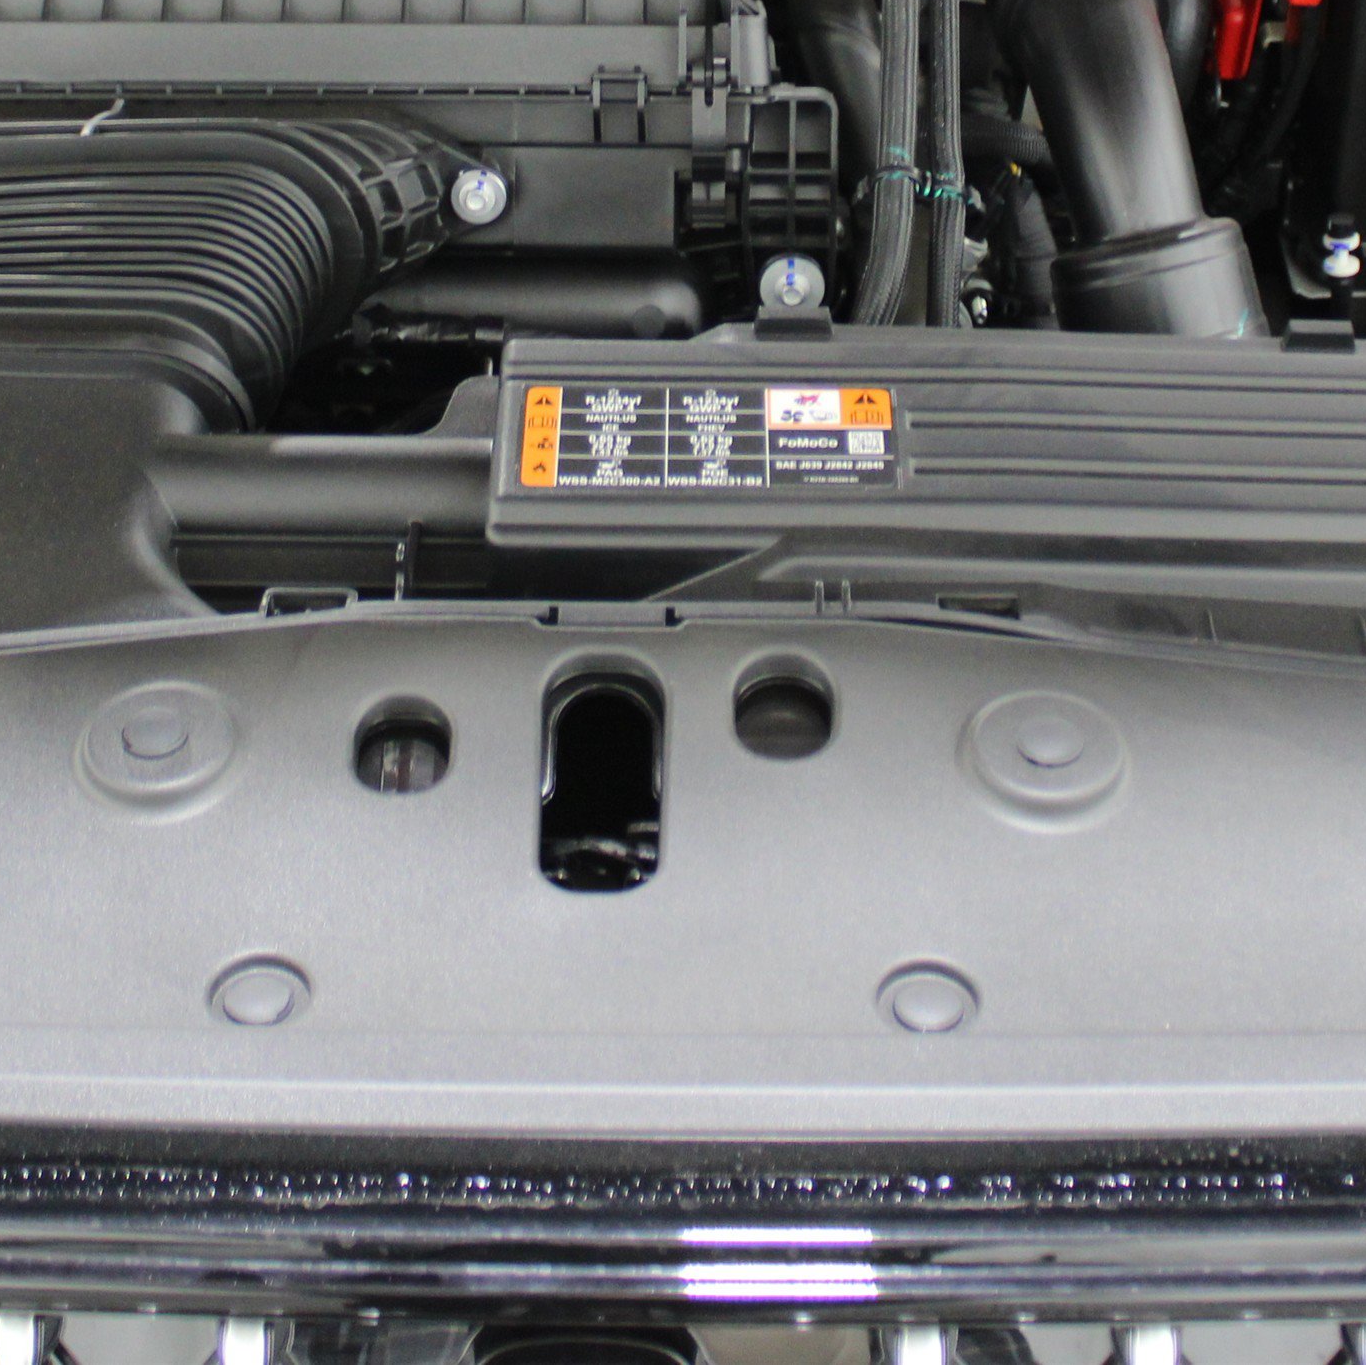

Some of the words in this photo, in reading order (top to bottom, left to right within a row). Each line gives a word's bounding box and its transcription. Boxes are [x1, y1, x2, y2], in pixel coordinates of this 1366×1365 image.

[586, 414, 637, 423] NAUTILUS
[686, 414, 737, 423] NAUTILUS
[778, 437, 838, 448] FoMoCo
